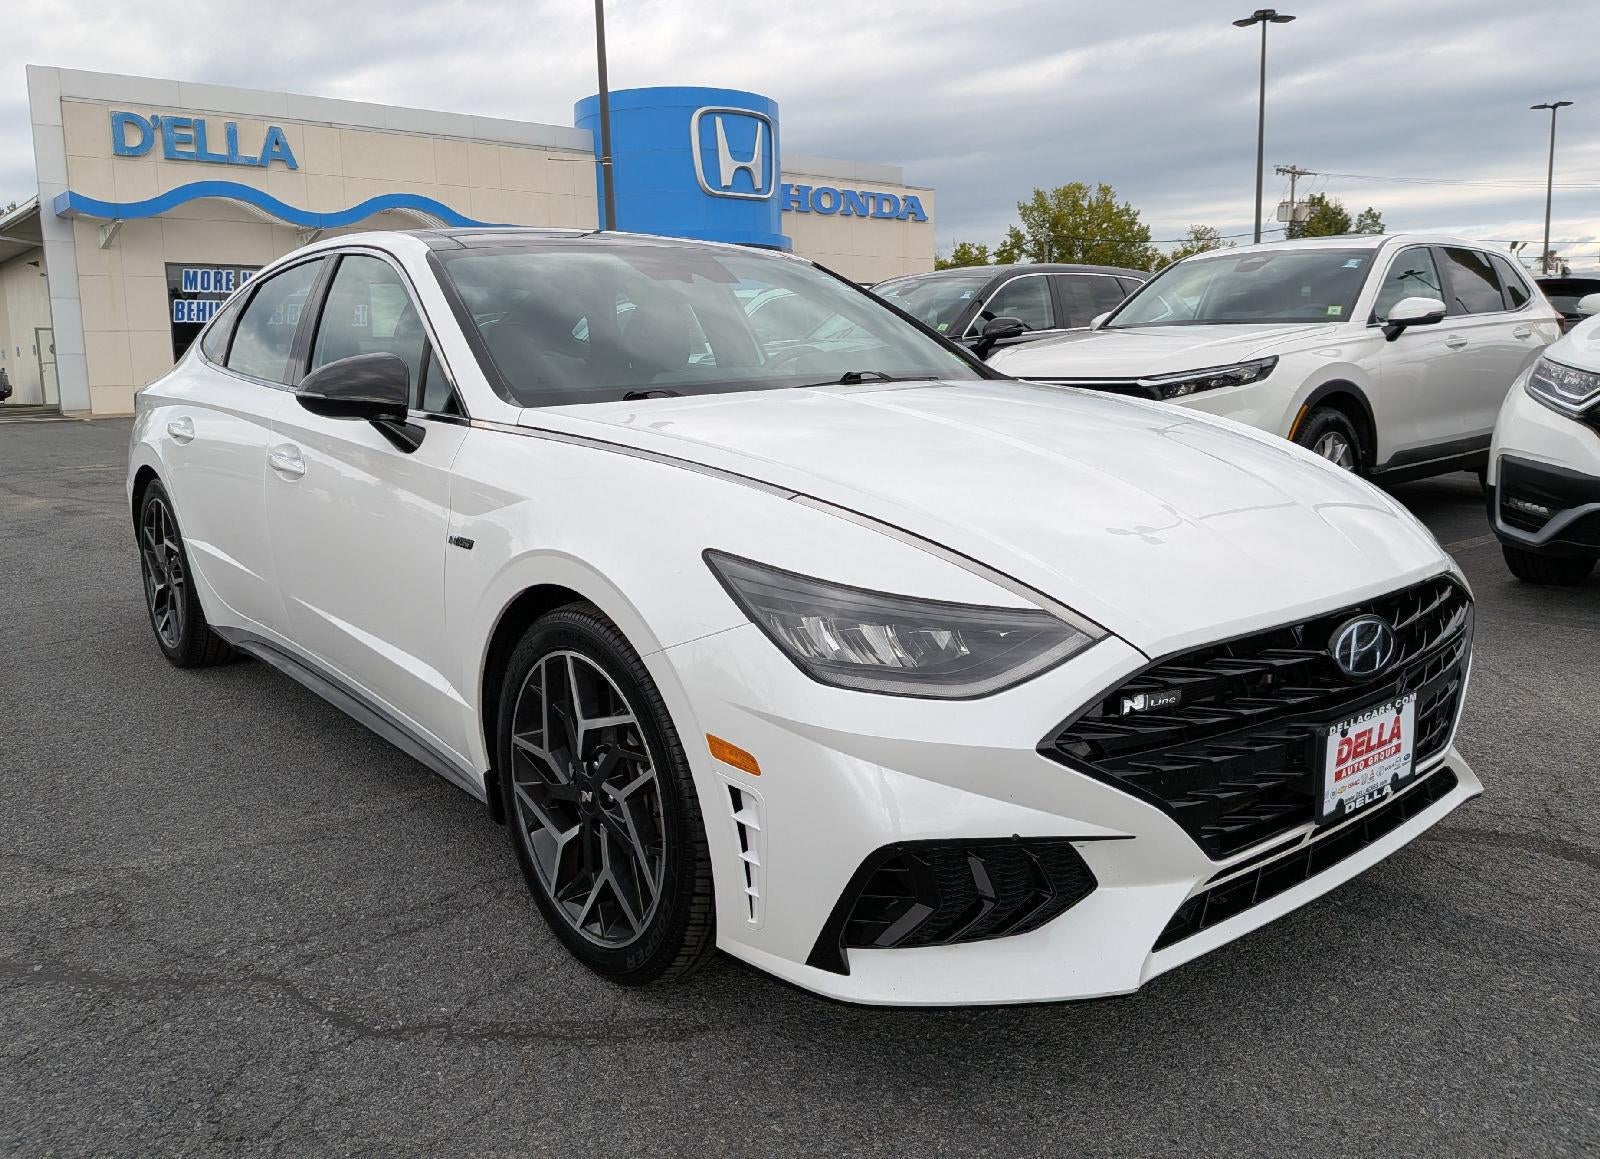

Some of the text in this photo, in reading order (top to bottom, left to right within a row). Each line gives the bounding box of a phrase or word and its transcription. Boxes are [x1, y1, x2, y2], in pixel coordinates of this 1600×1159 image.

[110, 111, 299, 169] D'ELLA
[781, 184, 928, 221] HONDA
[182, 269, 235, 293] MORE
[1335, 715, 1401, 768] DELLA
[1340, 762, 1365, 778] AUTO
[1368, 746, 1396, 766] GROUP
[1345, 785, 1392, 814] DELLA
